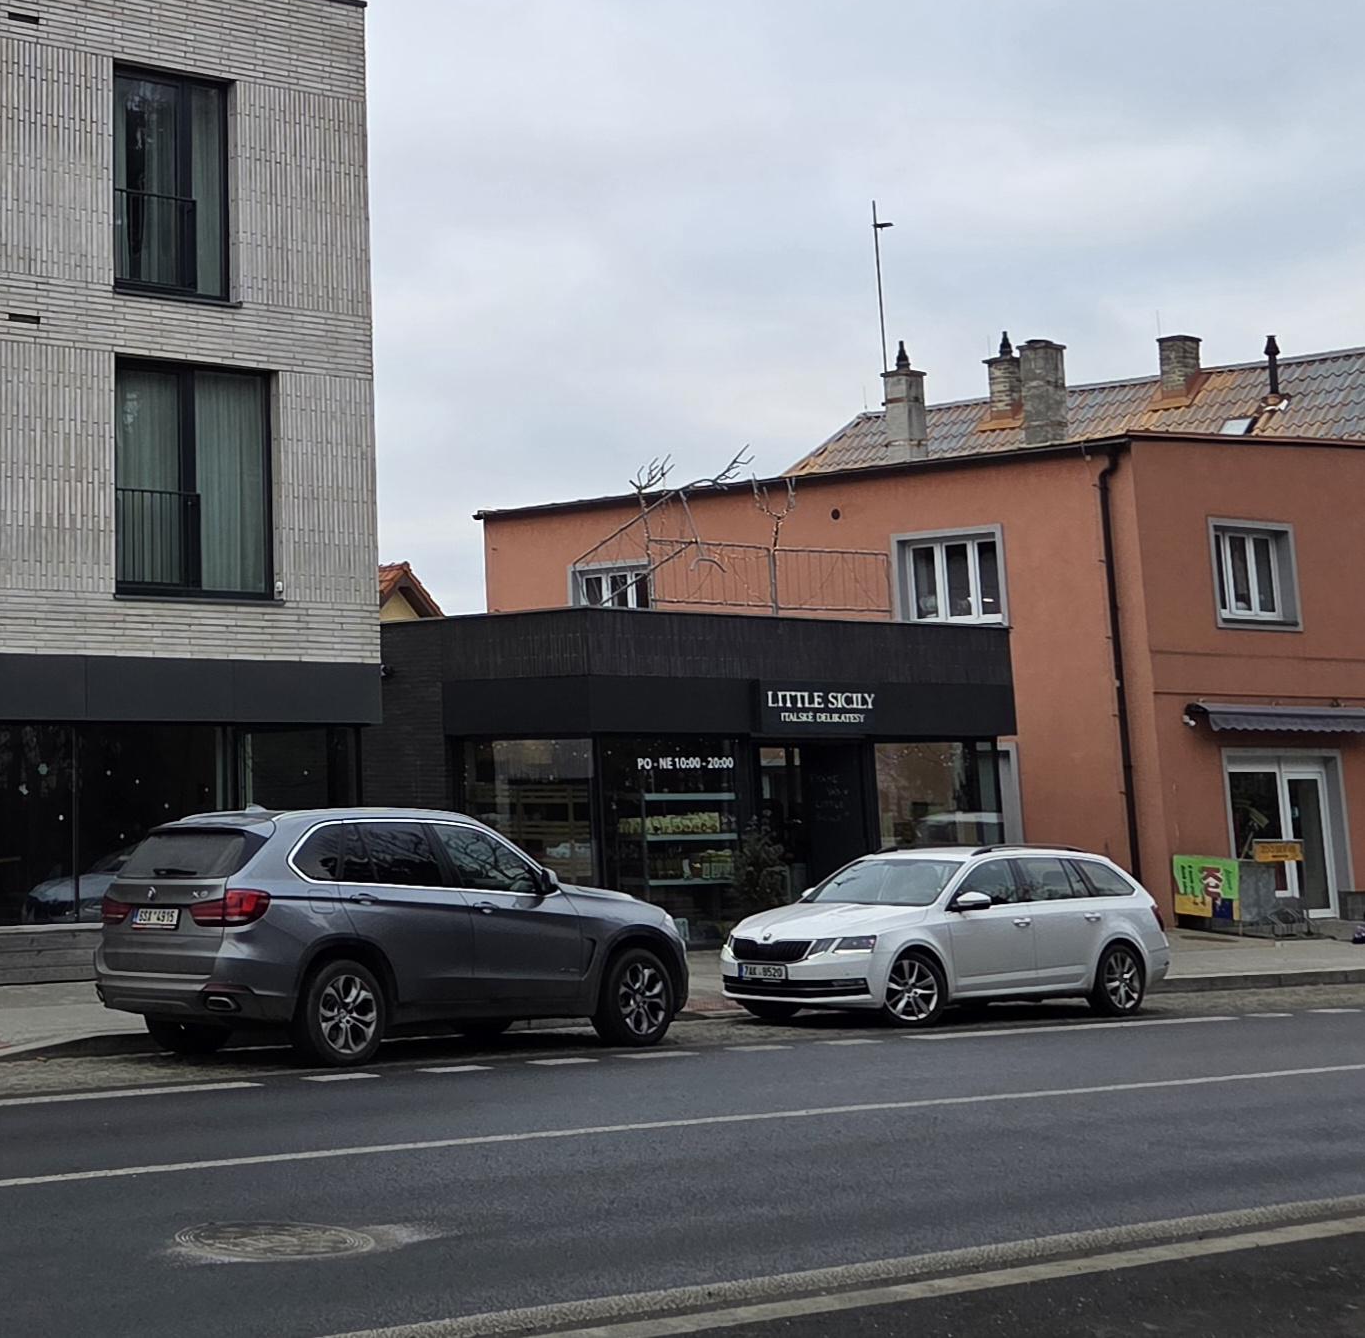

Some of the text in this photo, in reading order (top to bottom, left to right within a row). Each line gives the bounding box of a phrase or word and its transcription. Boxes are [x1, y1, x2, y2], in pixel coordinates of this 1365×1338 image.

[766, 690, 876, 710] LITTLE SICILY
[780, 711, 866, 723] ITALSKÉ DELIKATESY
[636, 757, 653, 771] PO
[658, 756, 674, 771] NE
[674, 756, 702, 770] 10:00
[707, 756, 735, 769] 20:00
